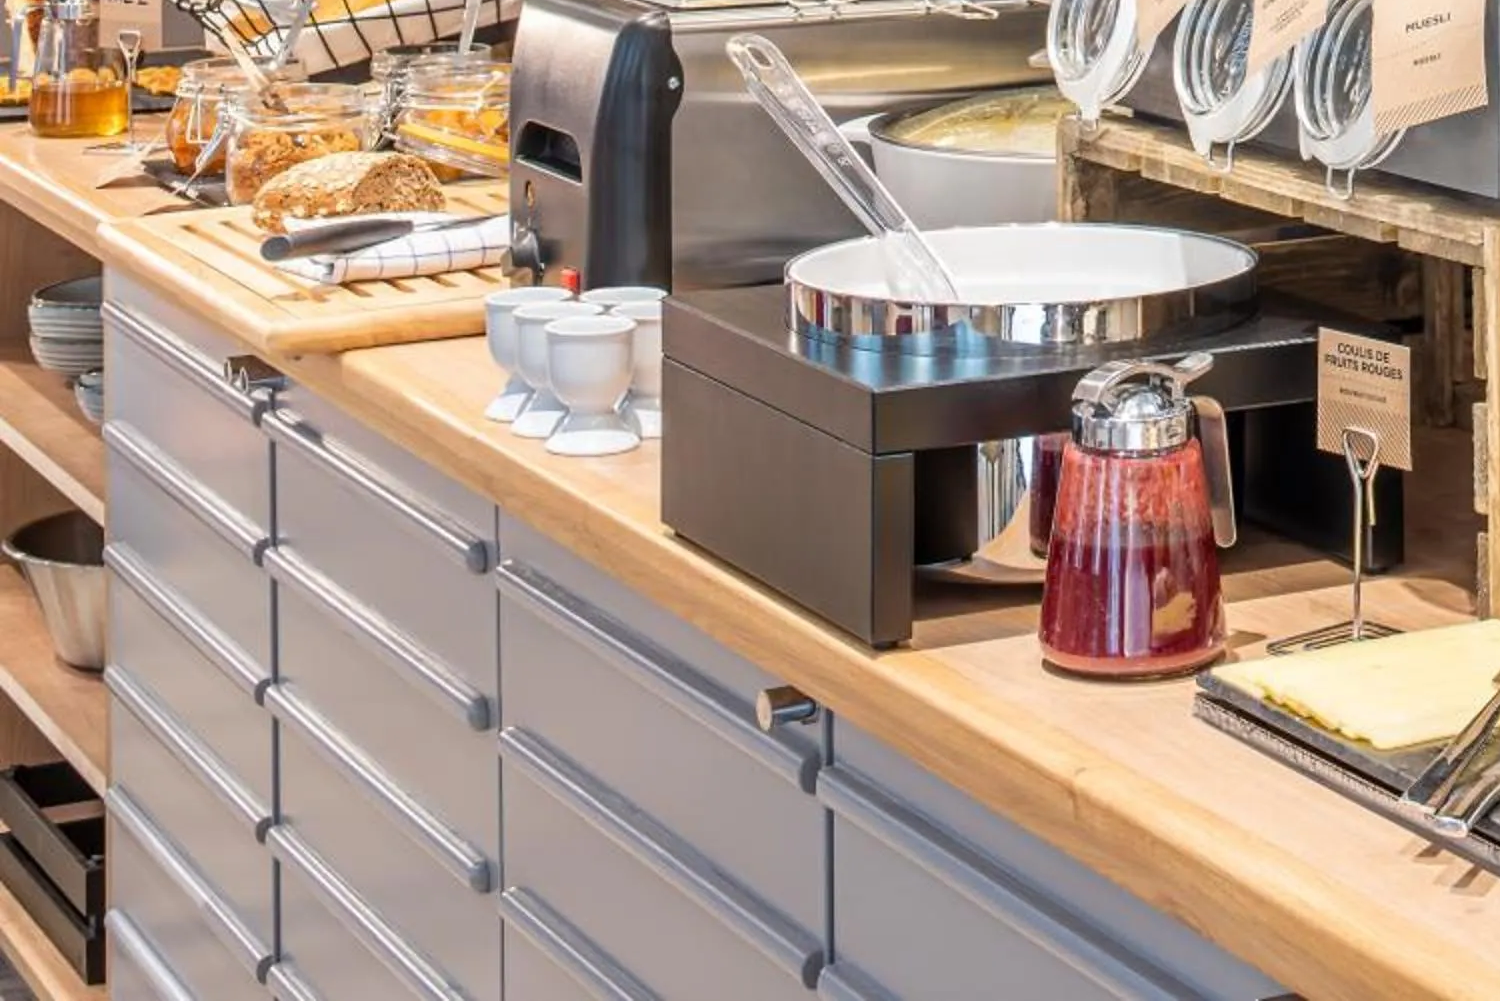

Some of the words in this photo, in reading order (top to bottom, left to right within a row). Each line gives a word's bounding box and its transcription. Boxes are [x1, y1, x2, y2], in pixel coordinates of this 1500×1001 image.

[1405, 11, 1452, 34] MUESLI
[1337, 342, 1374, 360] COULIS
[1376, 350, 1390, 364] DE
[1325, 353, 1359, 372] FRUITS
[1361, 362, 1403, 380] ROUGES
